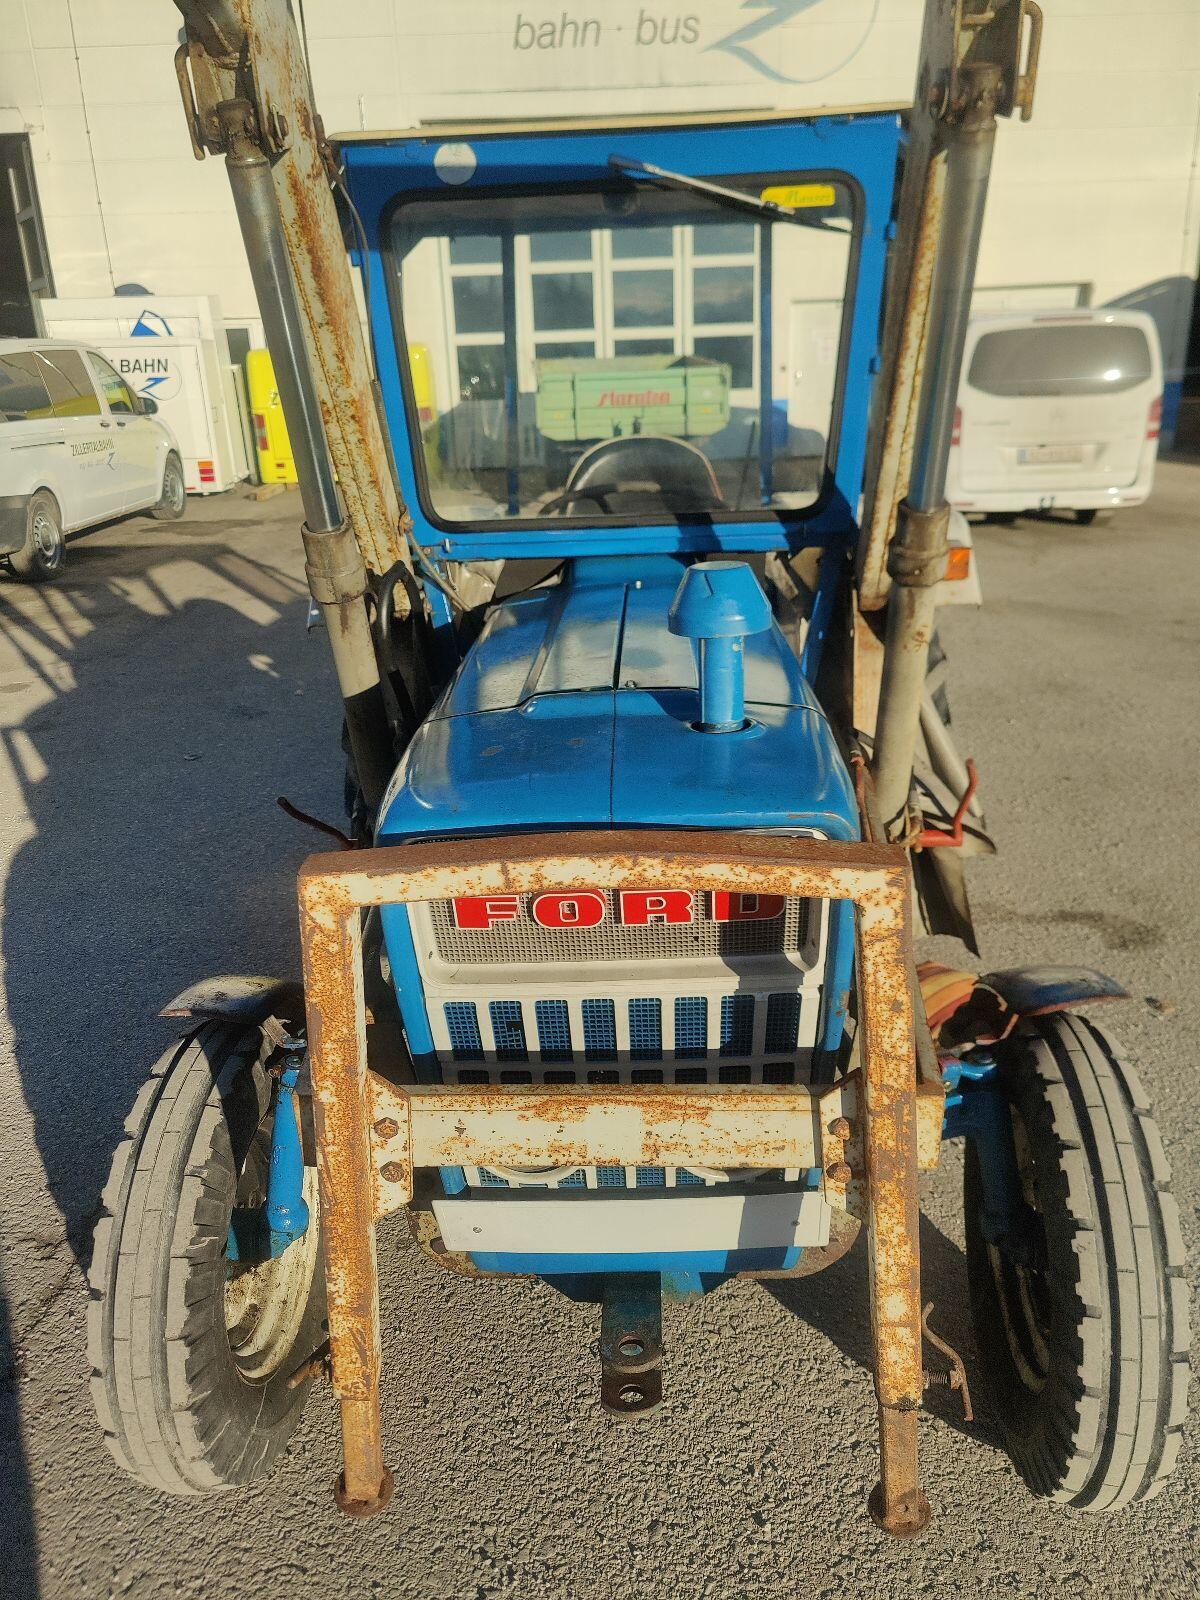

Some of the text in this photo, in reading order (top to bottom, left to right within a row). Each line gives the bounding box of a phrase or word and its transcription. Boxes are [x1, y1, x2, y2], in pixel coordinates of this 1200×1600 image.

[513, 9, 700, 50] bahn bus
[111, 358, 168, 373] BAHN
[452, 889, 786, 931] FORD
